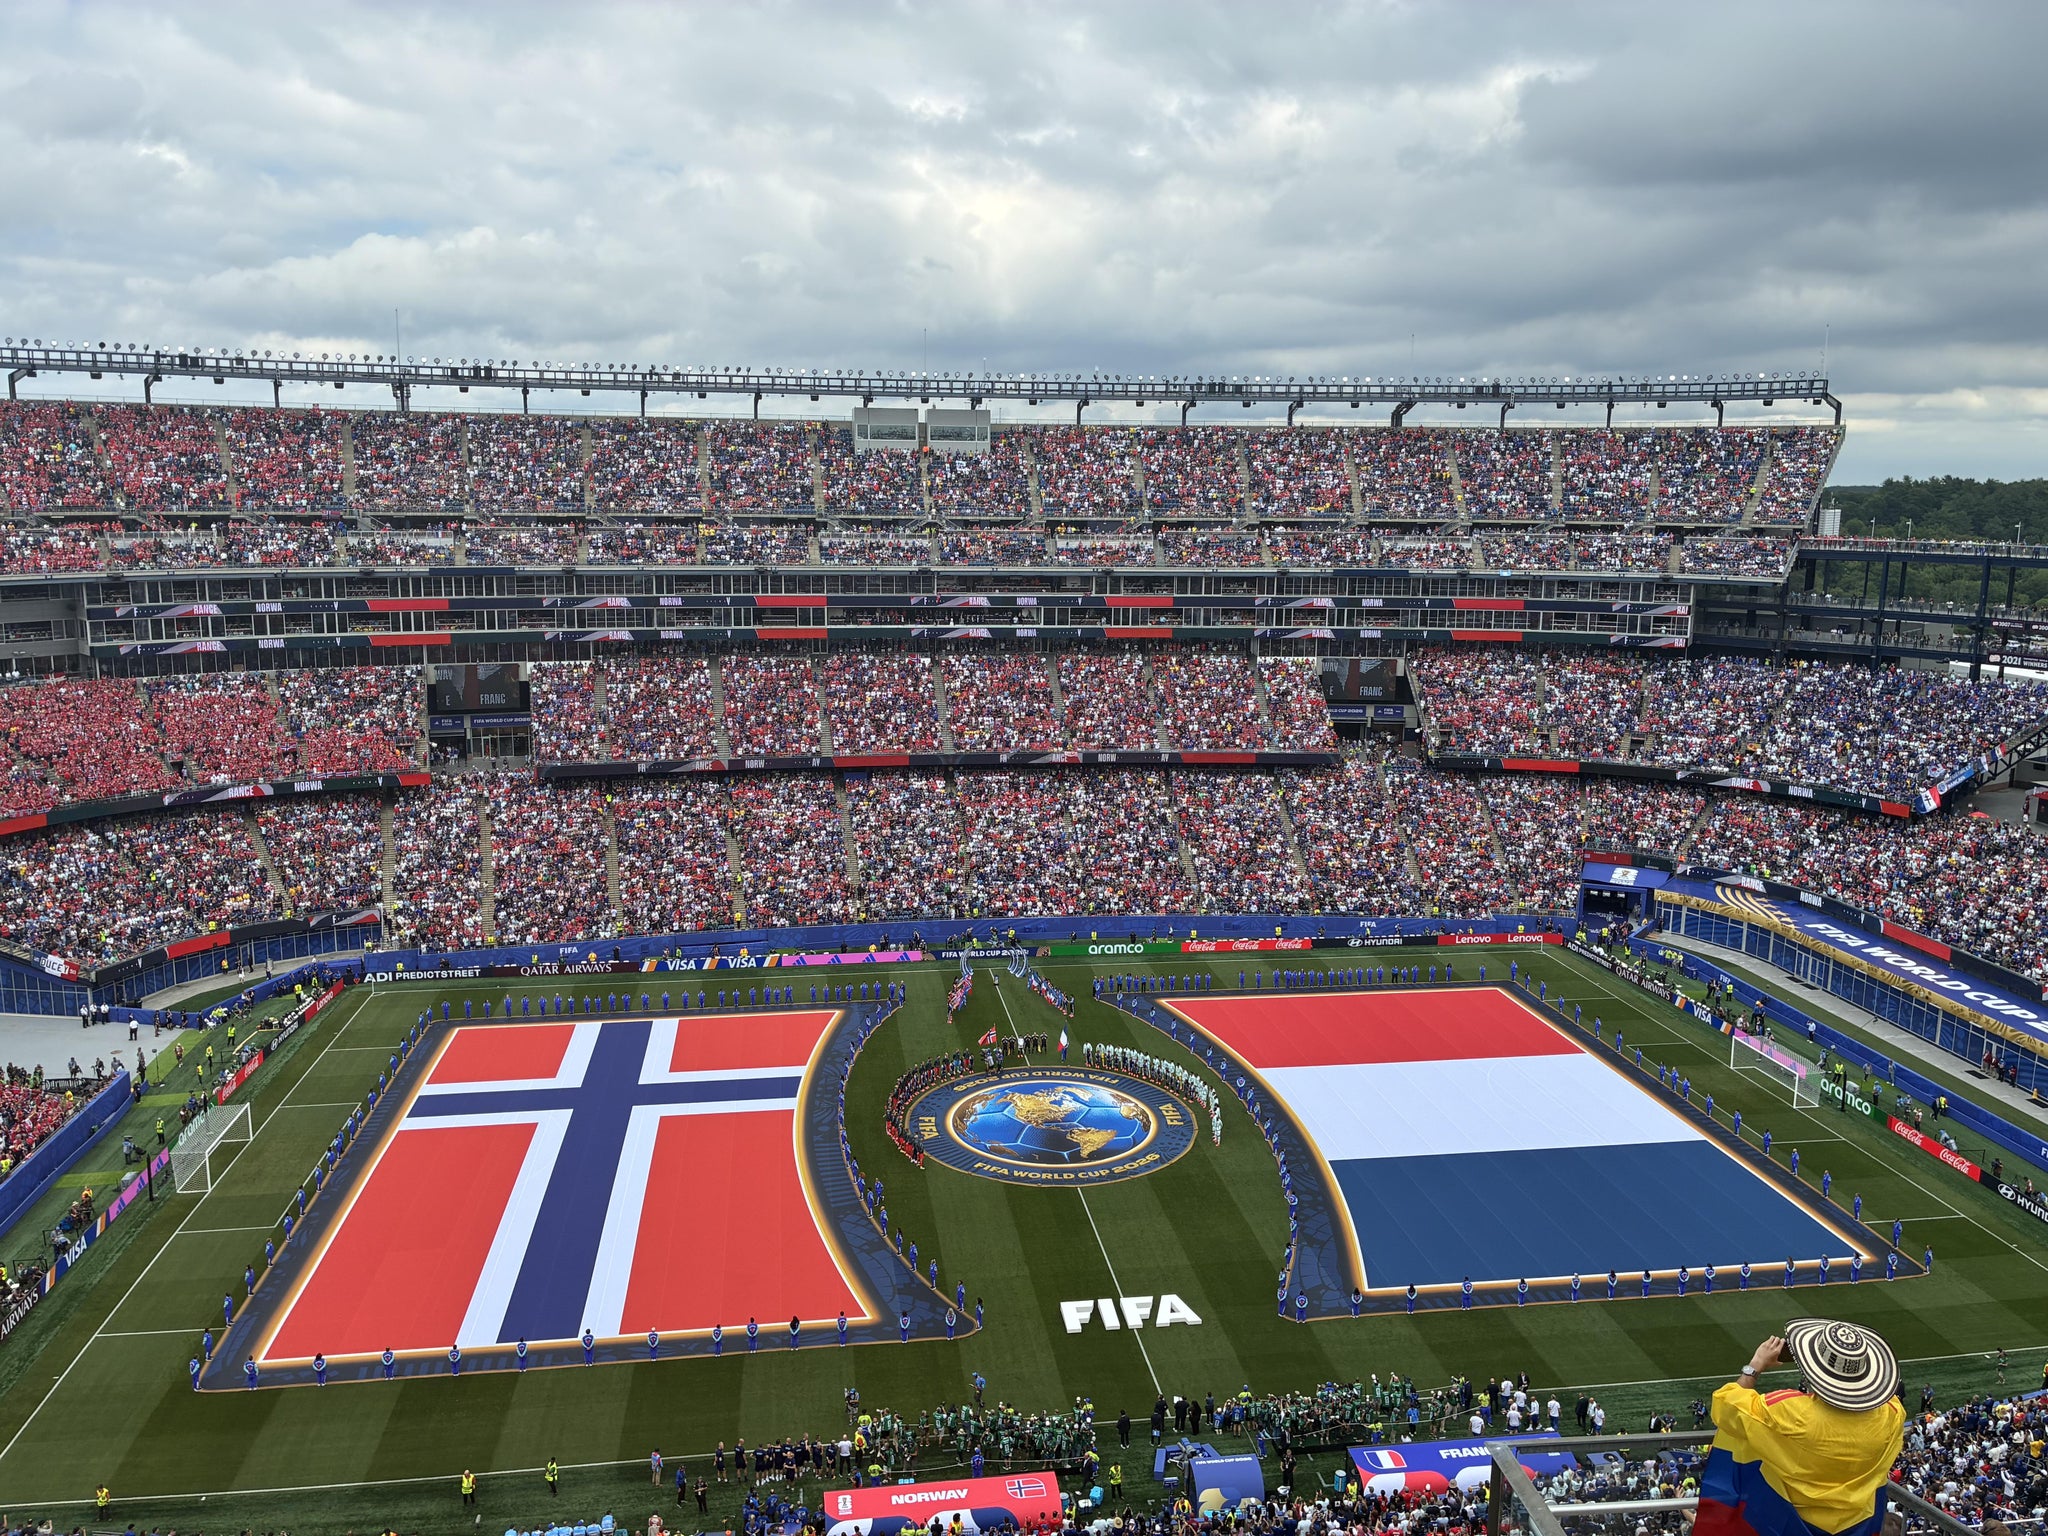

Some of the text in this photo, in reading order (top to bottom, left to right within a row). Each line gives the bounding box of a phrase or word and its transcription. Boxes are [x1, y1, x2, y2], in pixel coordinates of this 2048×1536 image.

[2002, 655, 2021, 665] 2021
[1456, 935, 1491, 944] Lenovo
[1508, 934, 1543, 943] Lenovo
[560, 946, 578, 954] FIFA
[1088, 944, 1144, 954] aramco
[1567, 942, 1579, 953] ADI
[40, 957, 69, 974] DUCEY
[520, 964, 612, 976] QATAR AIRWAYS
[667, 959, 696, 970] VISA
[728, 957, 756, 968] VISA
[1805, 923, 1869, 947] FIFA
[1861, 947, 1970, 991] WORLD
[1964, 991, 2038, 1019] CUP
[364, 969, 481, 983] ADI PREDICTSTREET
[1615, 965, 1671, 1000] QATAR AIRWAYS
[316, 990, 334, 1011] Lenovo
[1694, 1004, 1712, 1024] VISA
[278, 1020, 299, 1043] HYUNDAI
[1023, 1070, 1084, 1080] WORLD
[1088, 1072, 1120, 1085] FIFA
[1820, 1078, 1872, 1115] aramco
[1158, 1103, 1184, 1126] FIFA
[918, 1116, 939, 1140] FIFA
[974, 1153, 1161, 1180] FIFA WORLD CUP 2026
[64, 1235, 87, 1268] VISA
[0, 1288, 38, 1340] AIRWAYS
[1060, 1294, 1202, 1334] FIFA
[890, 1488, 968, 1505] NORWAY
